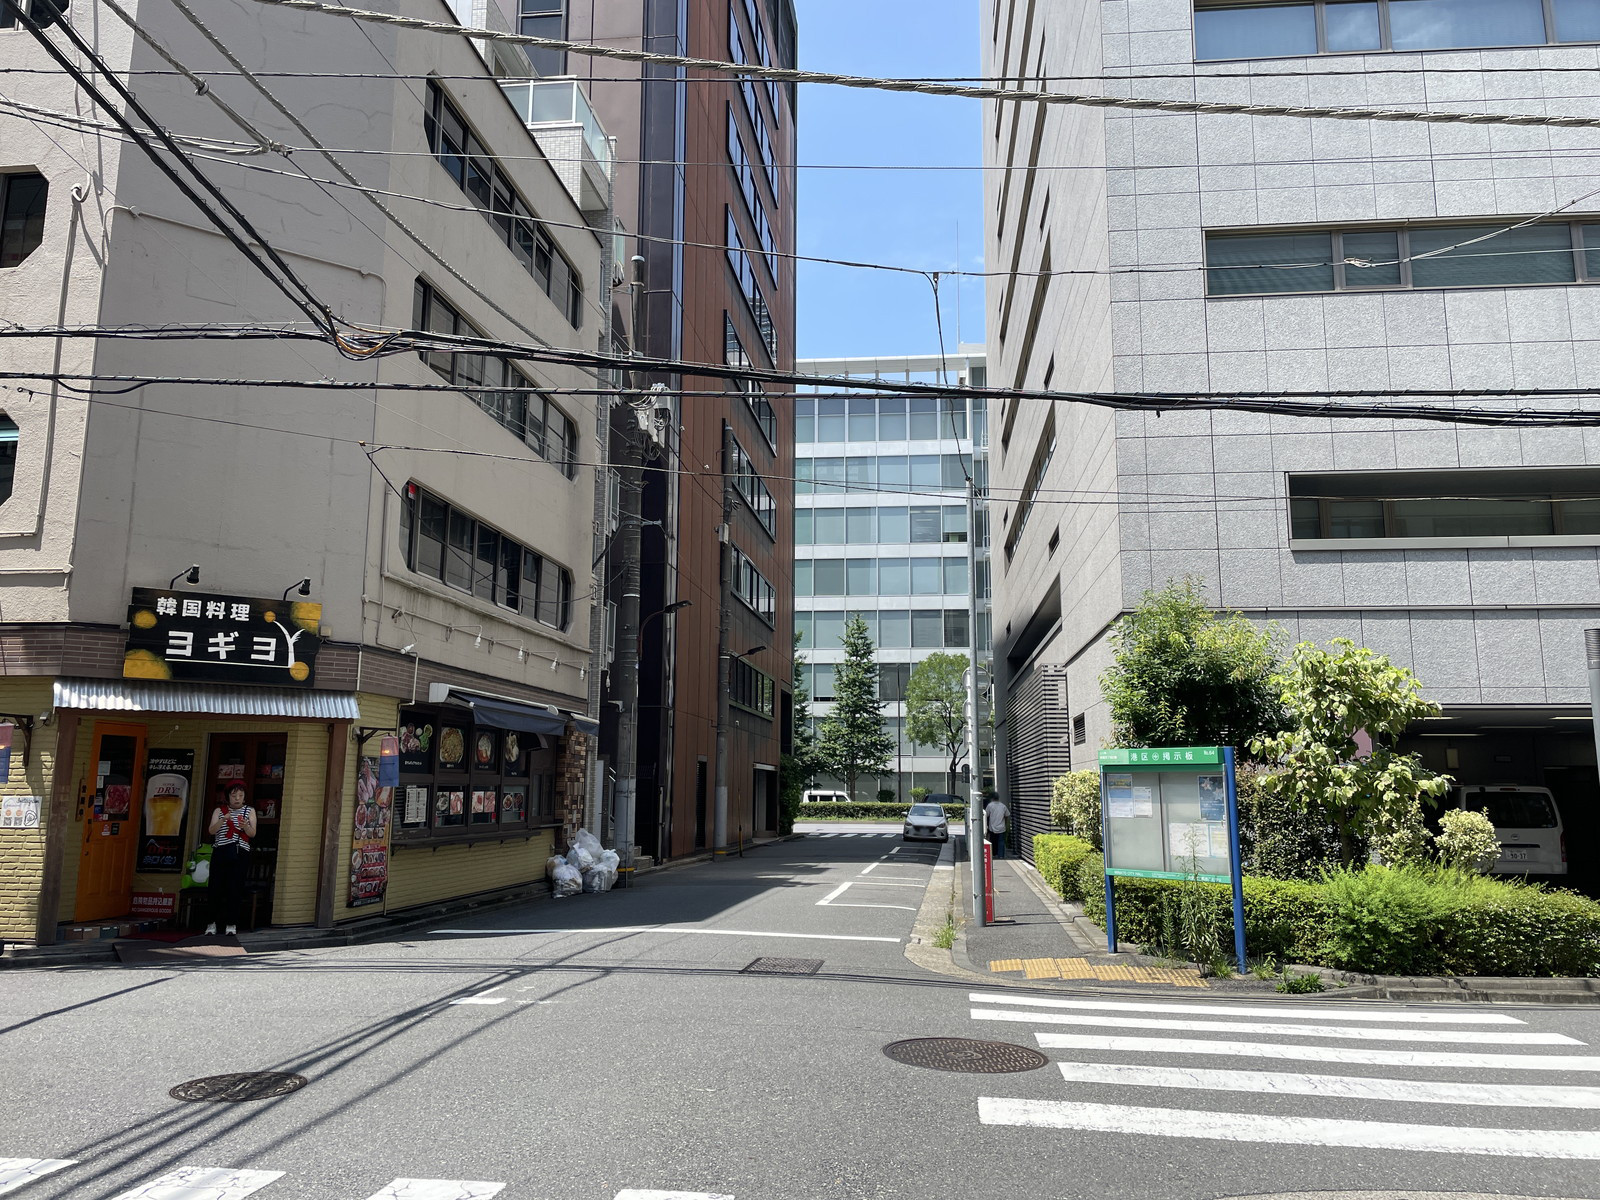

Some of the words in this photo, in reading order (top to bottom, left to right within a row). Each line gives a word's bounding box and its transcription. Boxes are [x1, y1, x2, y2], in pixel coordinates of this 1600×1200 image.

[156, 596, 250, 622] 韓国料理
[1162, 751, 1194, 761] 掲示板
